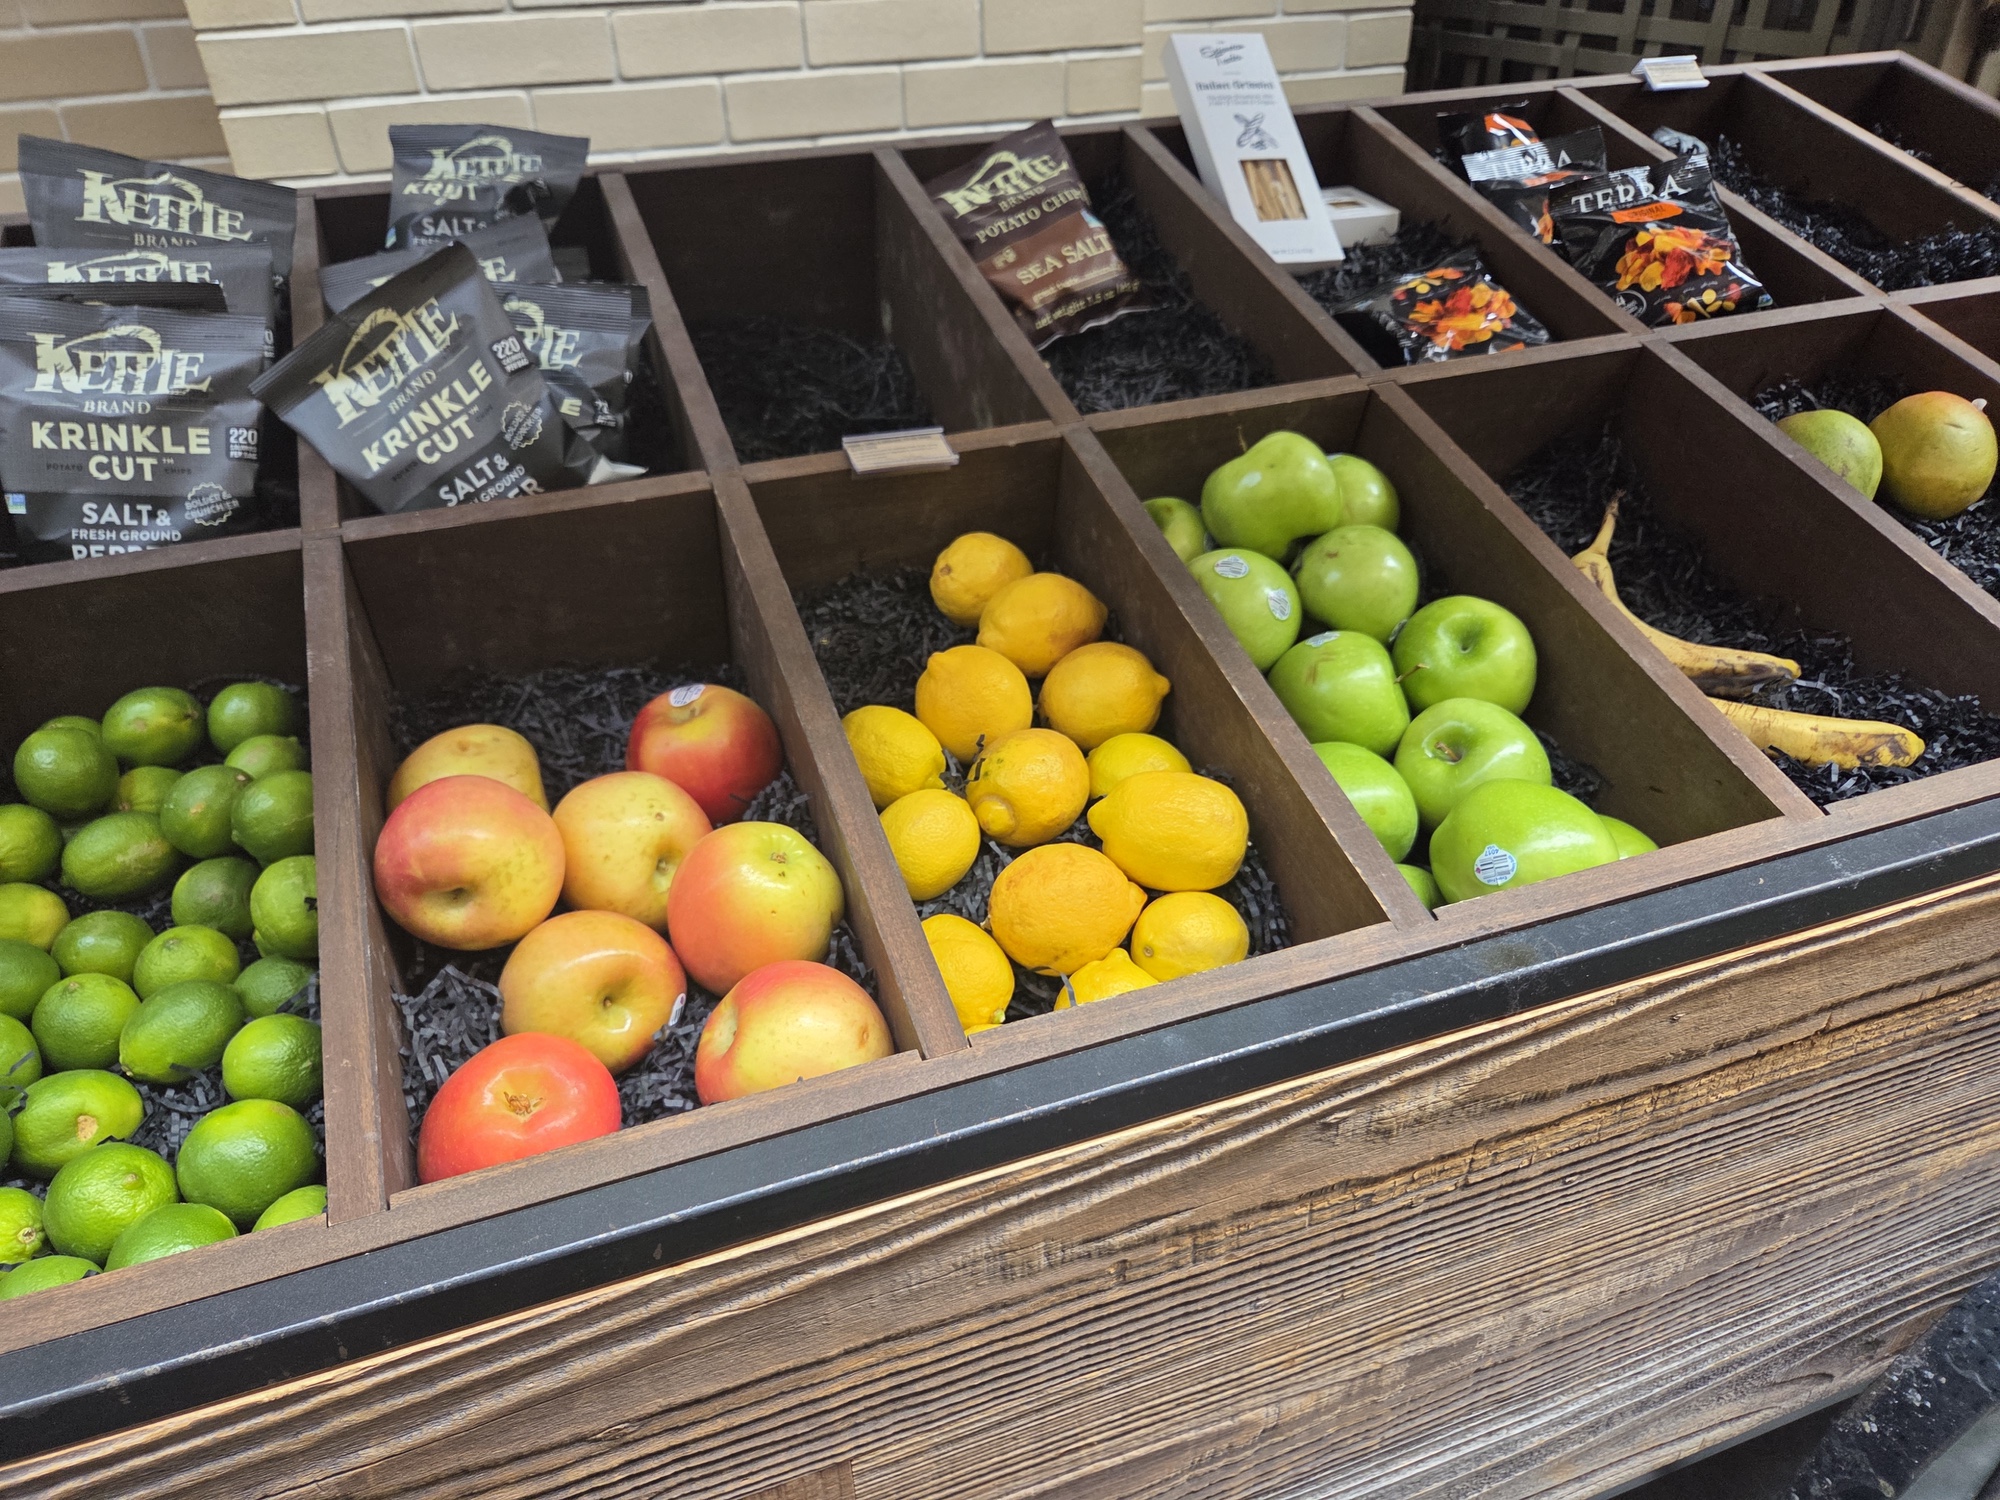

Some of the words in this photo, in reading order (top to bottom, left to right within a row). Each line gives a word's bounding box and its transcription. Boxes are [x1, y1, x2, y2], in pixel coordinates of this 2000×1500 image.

[75, 168, 253, 242] KETTLE
[1570, 173, 1693, 214] TERRA
[422, 216, 476, 237] SALT
[975, 206, 1042, 245] POTATO
[1015, 254, 1064, 286] SEA
[1060, 232, 1114, 265] SALT
[24, 325, 212, 396] KETTLE
[308, 296, 460, 430] KETTLE
[491, 335, 521, 360] 220
[82, 399, 152, 415] BRAND
[388, 369, 437, 415] BRAND
[361, 358, 493, 472] KRINKLE
[31, 421, 212, 455] KRINKLE
[229, 427, 258, 446] 220
[438, 456, 496, 507] SALT
[493, 452, 510, 472] &
[480, 464, 525, 502] GROUND
[82, 501, 153, 527] SALT
[155, 508, 172, 527] &
[71, 528, 117, 541] FRESH
[119, 529, 183, 542] GROUND
[71, 543, 158, 561] PEP
